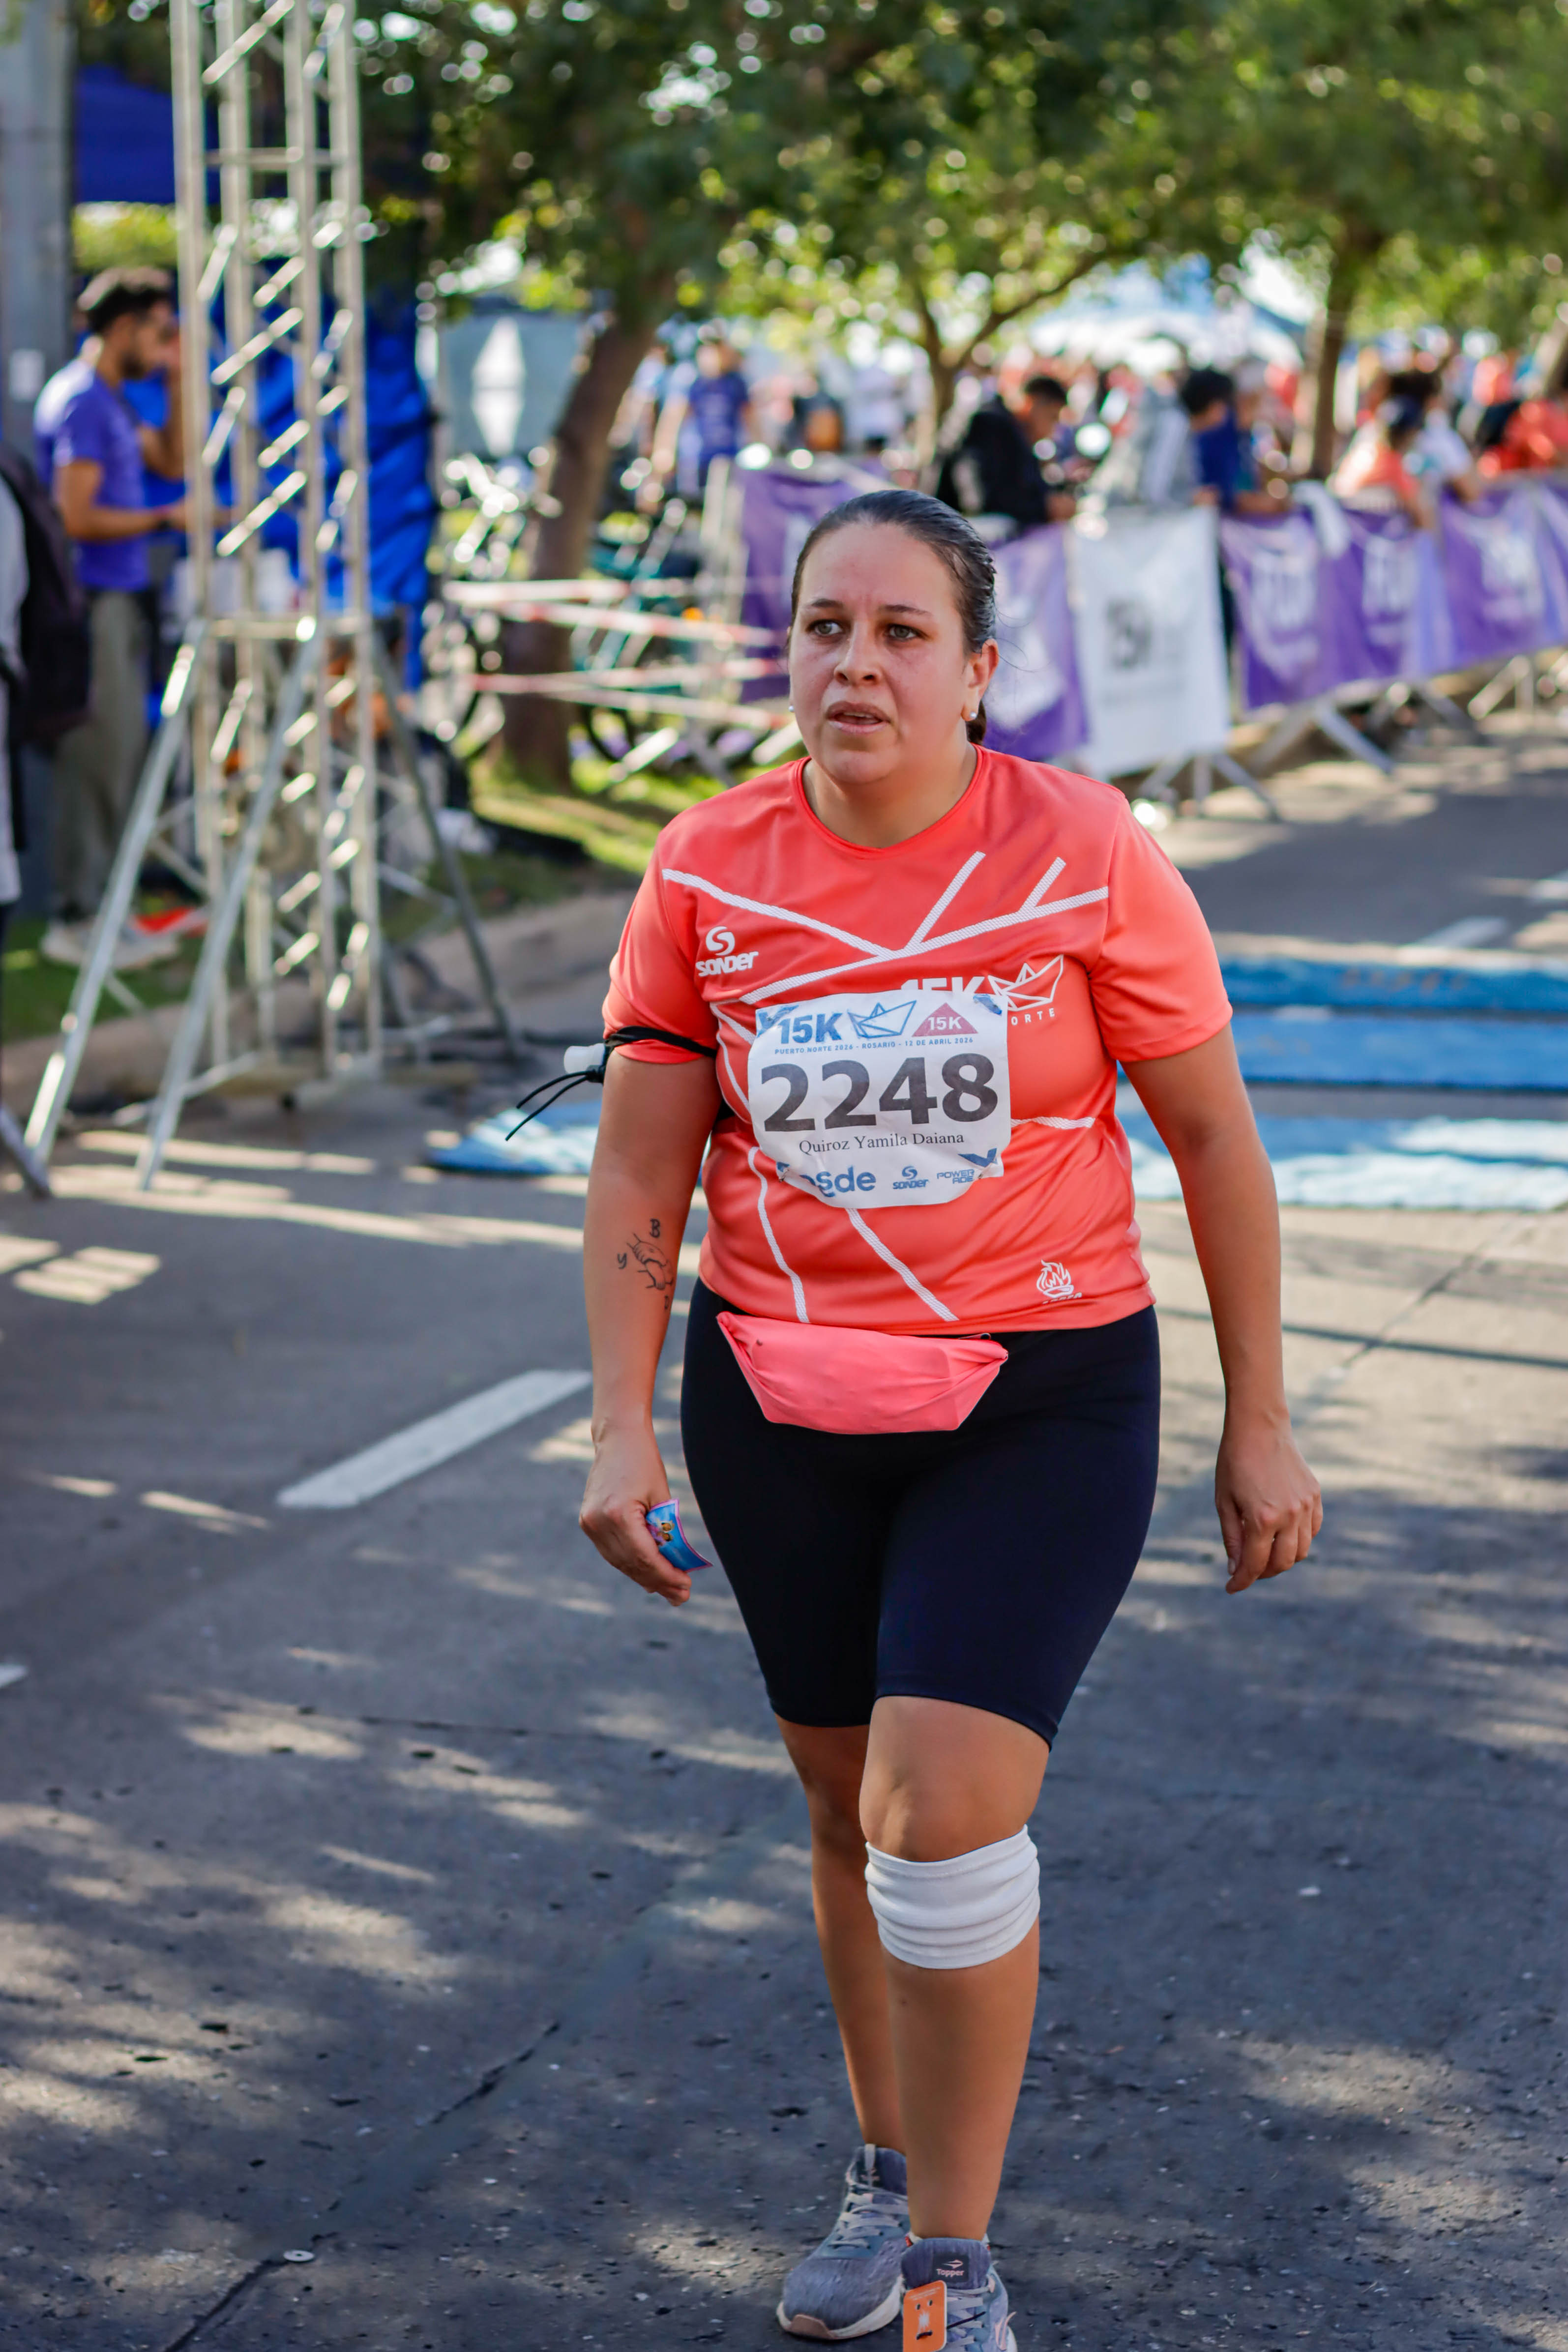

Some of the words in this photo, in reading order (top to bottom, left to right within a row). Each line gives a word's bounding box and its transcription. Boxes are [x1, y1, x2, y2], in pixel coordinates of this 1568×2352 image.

[928, 1016, 962, 1030] 15K
[1010, 1008, 1055, 1026] ORTE
[778, 1013, 843, 1044] 15K
[760, 1053, 998, 1132] 2248
[799, 1139, 850, 1155] Quiroz
[854, 1133, 908, 1148] Yamila
[912, 1132, 965, 1145] Daiana
[937, 1169, 975, 1179] POWER
[649, 1218, 661, 1238] B
[936, 2268, 964, 2277] Topper
